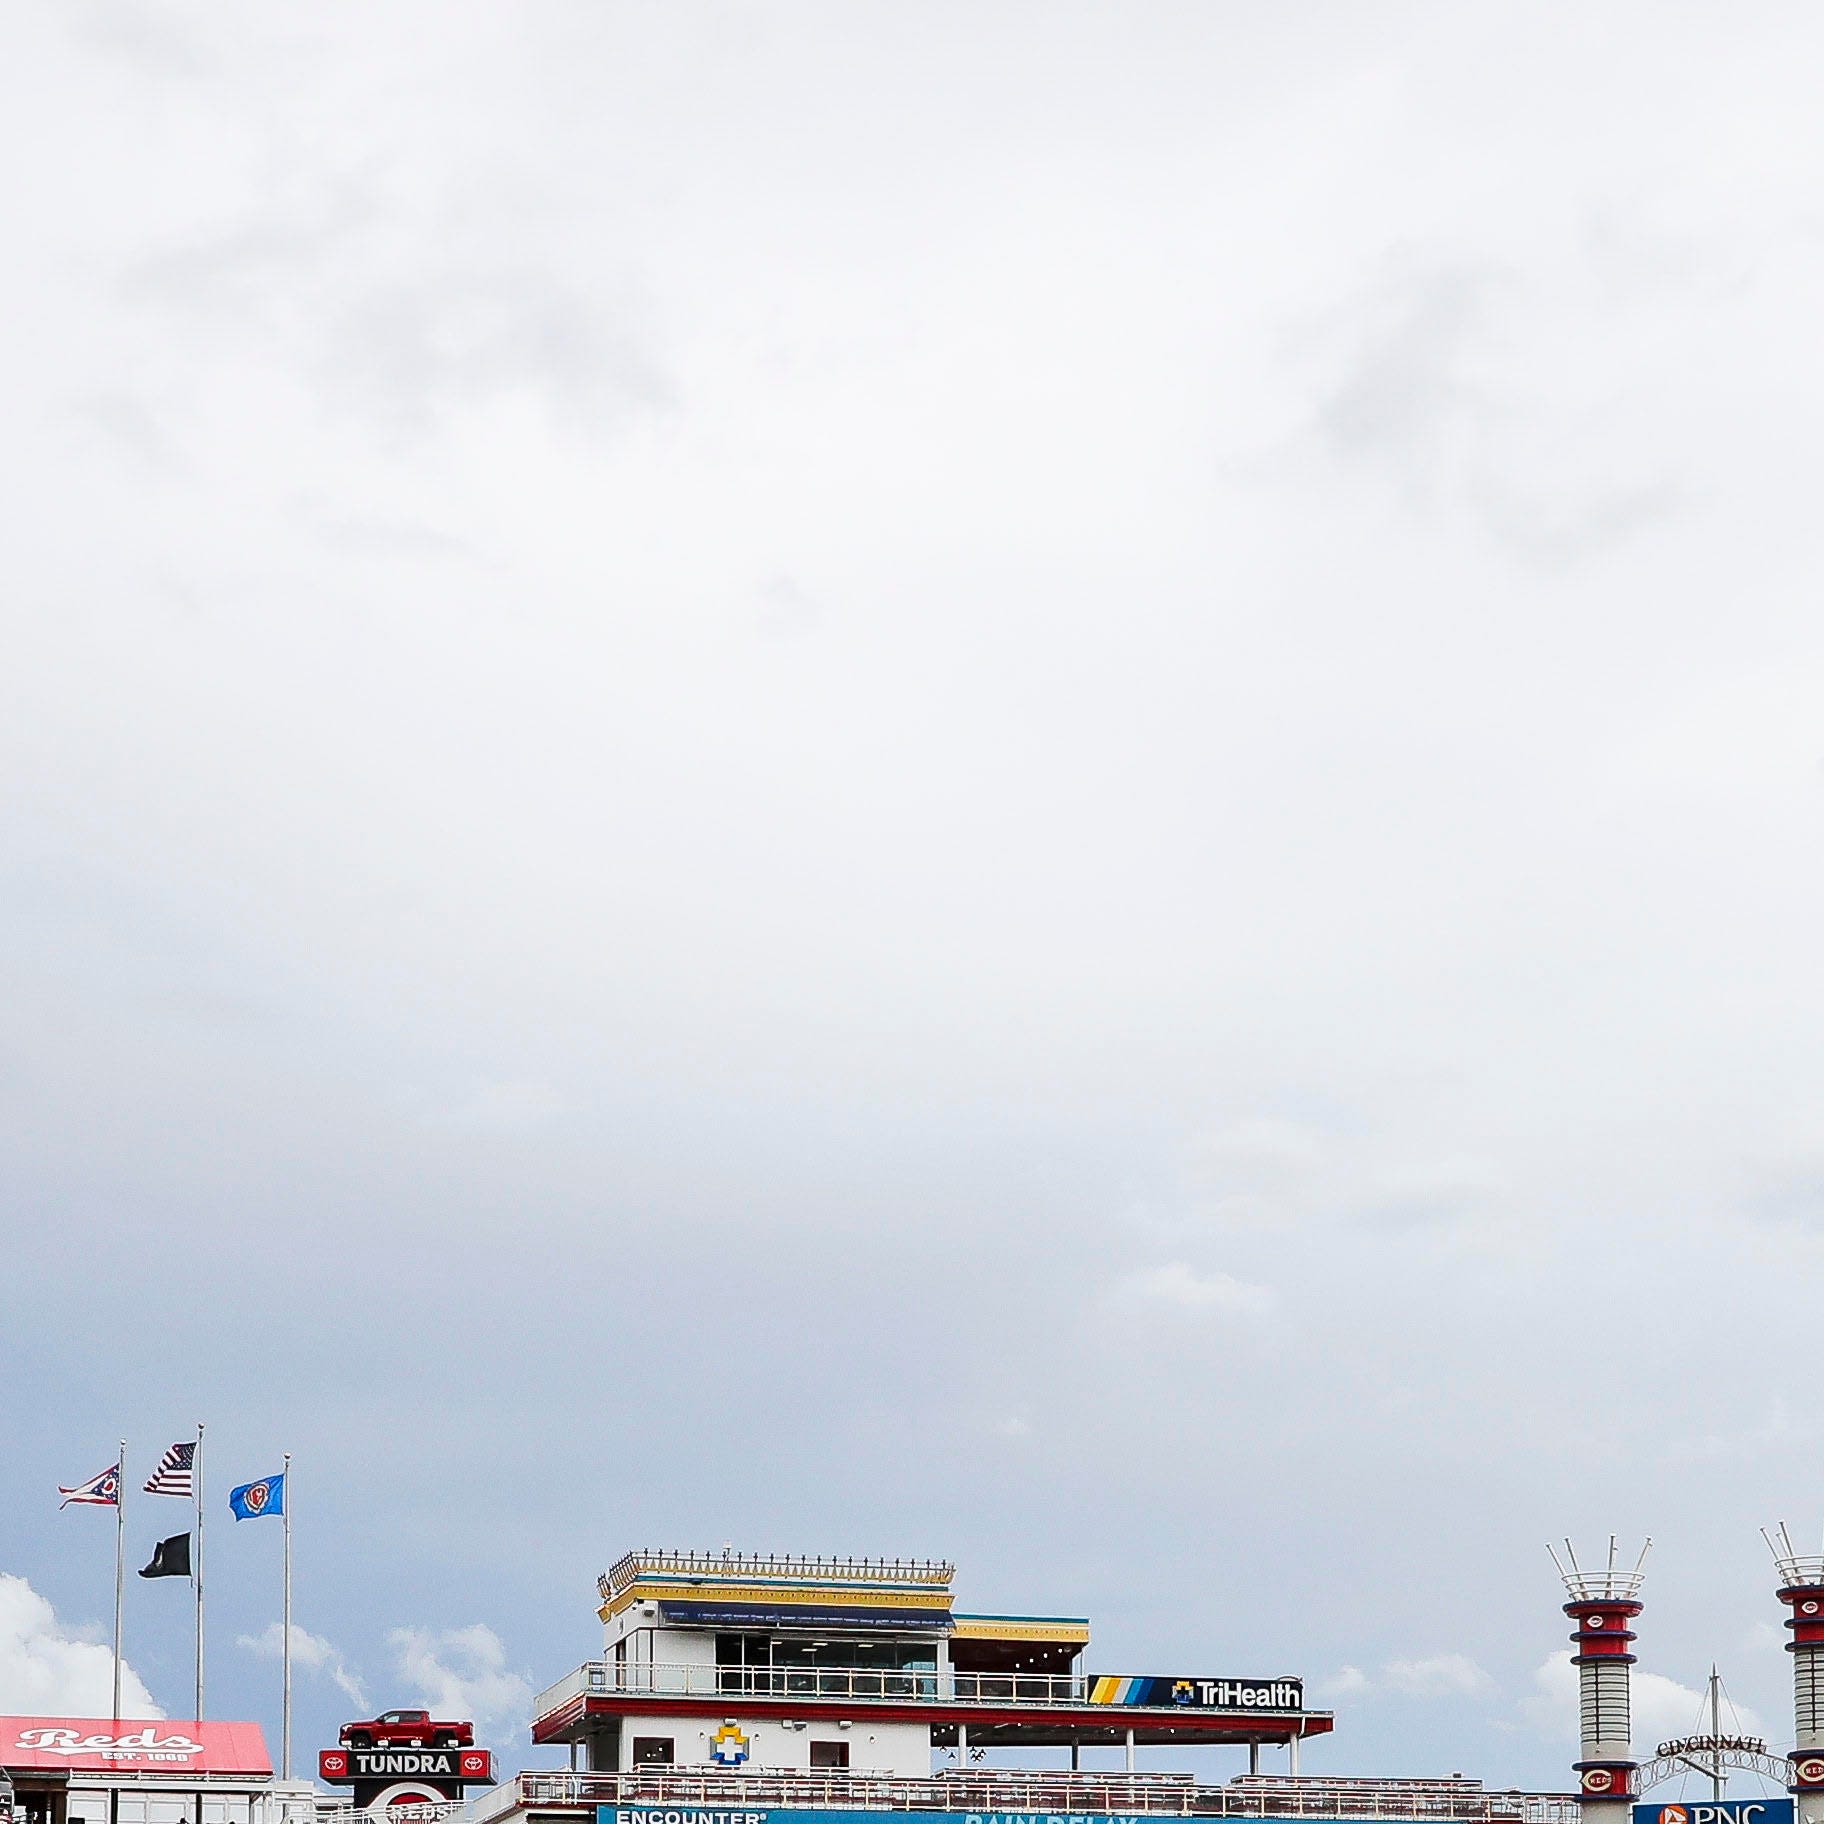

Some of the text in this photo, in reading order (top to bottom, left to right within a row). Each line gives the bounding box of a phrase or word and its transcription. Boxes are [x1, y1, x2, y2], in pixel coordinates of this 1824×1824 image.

[1196, 1679, 1301, 1709] TriHealth
[1657, 1736, 1765, 1755] CINCINNATI
[356, 1754, 451, 1774] TUNDRA
